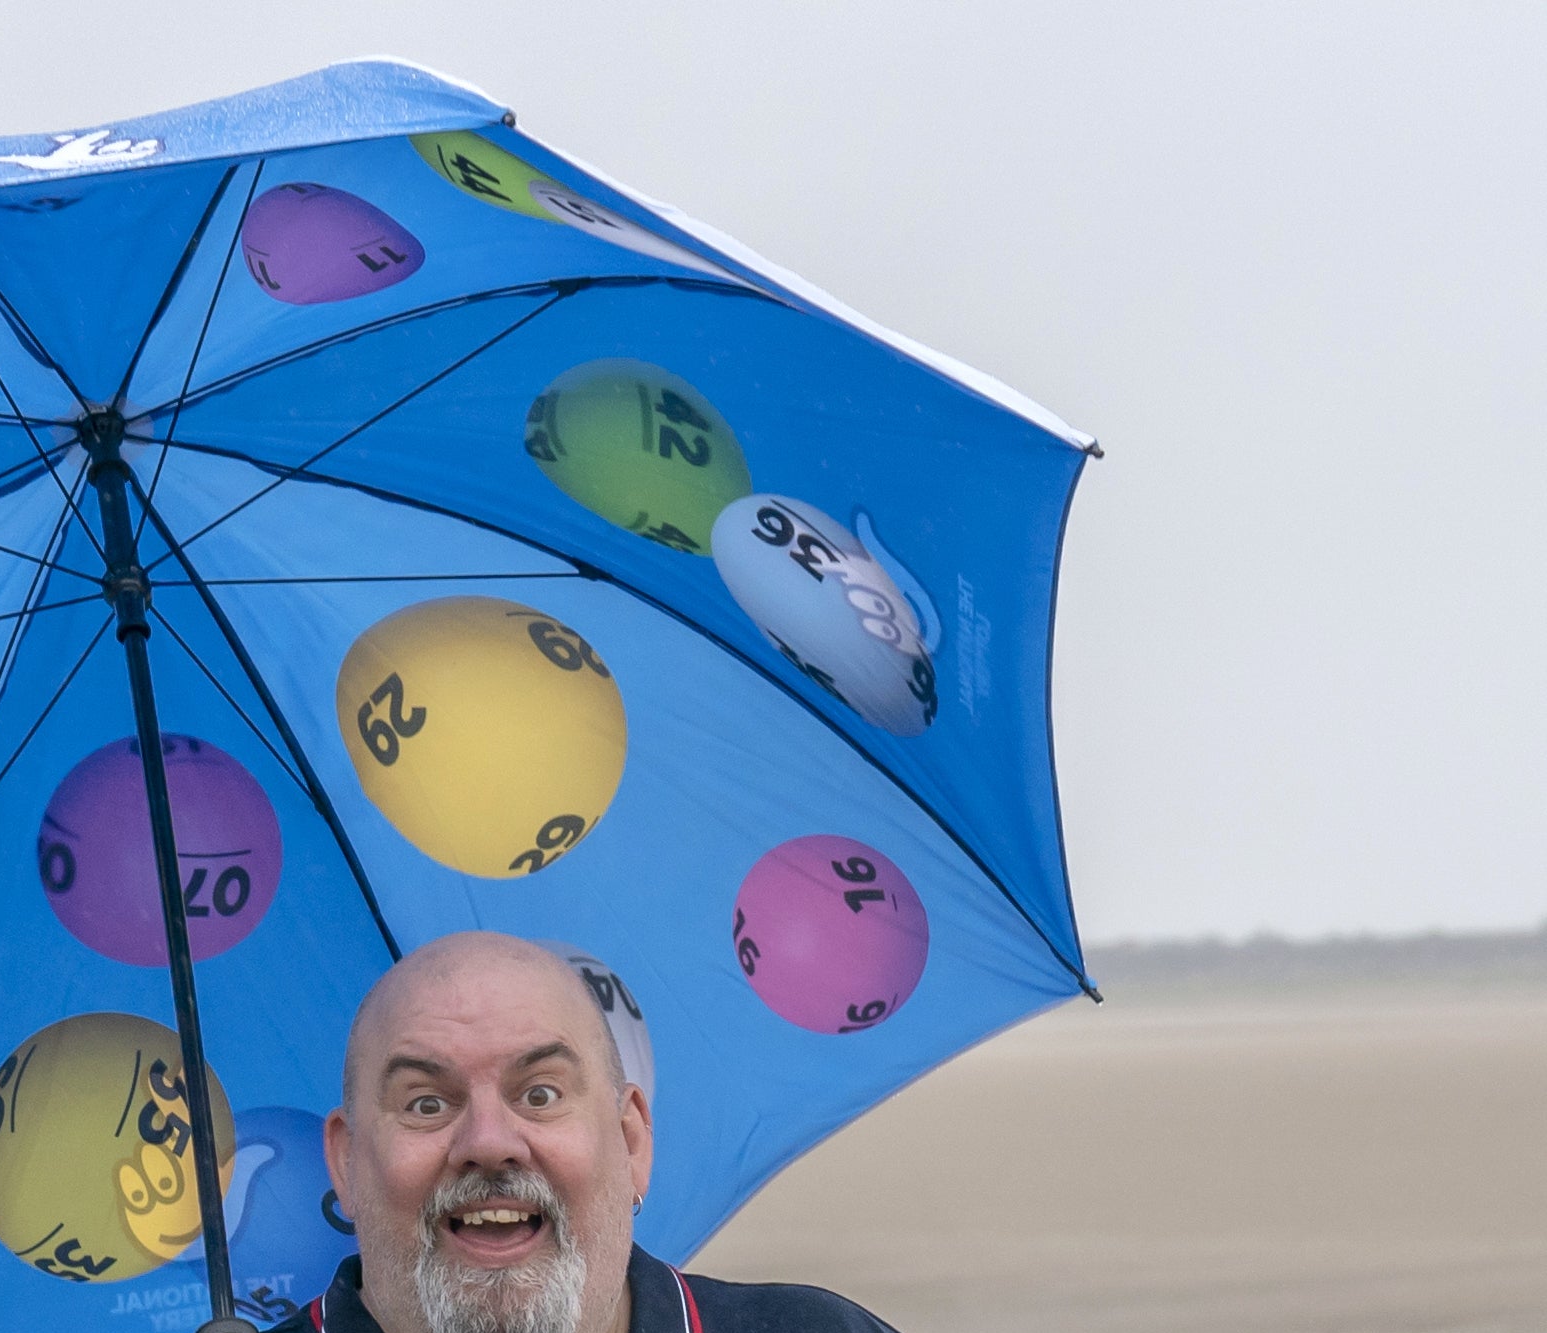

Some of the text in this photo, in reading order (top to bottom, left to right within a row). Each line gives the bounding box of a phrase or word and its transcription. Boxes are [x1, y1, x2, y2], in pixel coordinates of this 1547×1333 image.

[751, 505, 825, 584] 36
[356, 671, 427, 767] 29
[830, 856, 886, 915] 16
